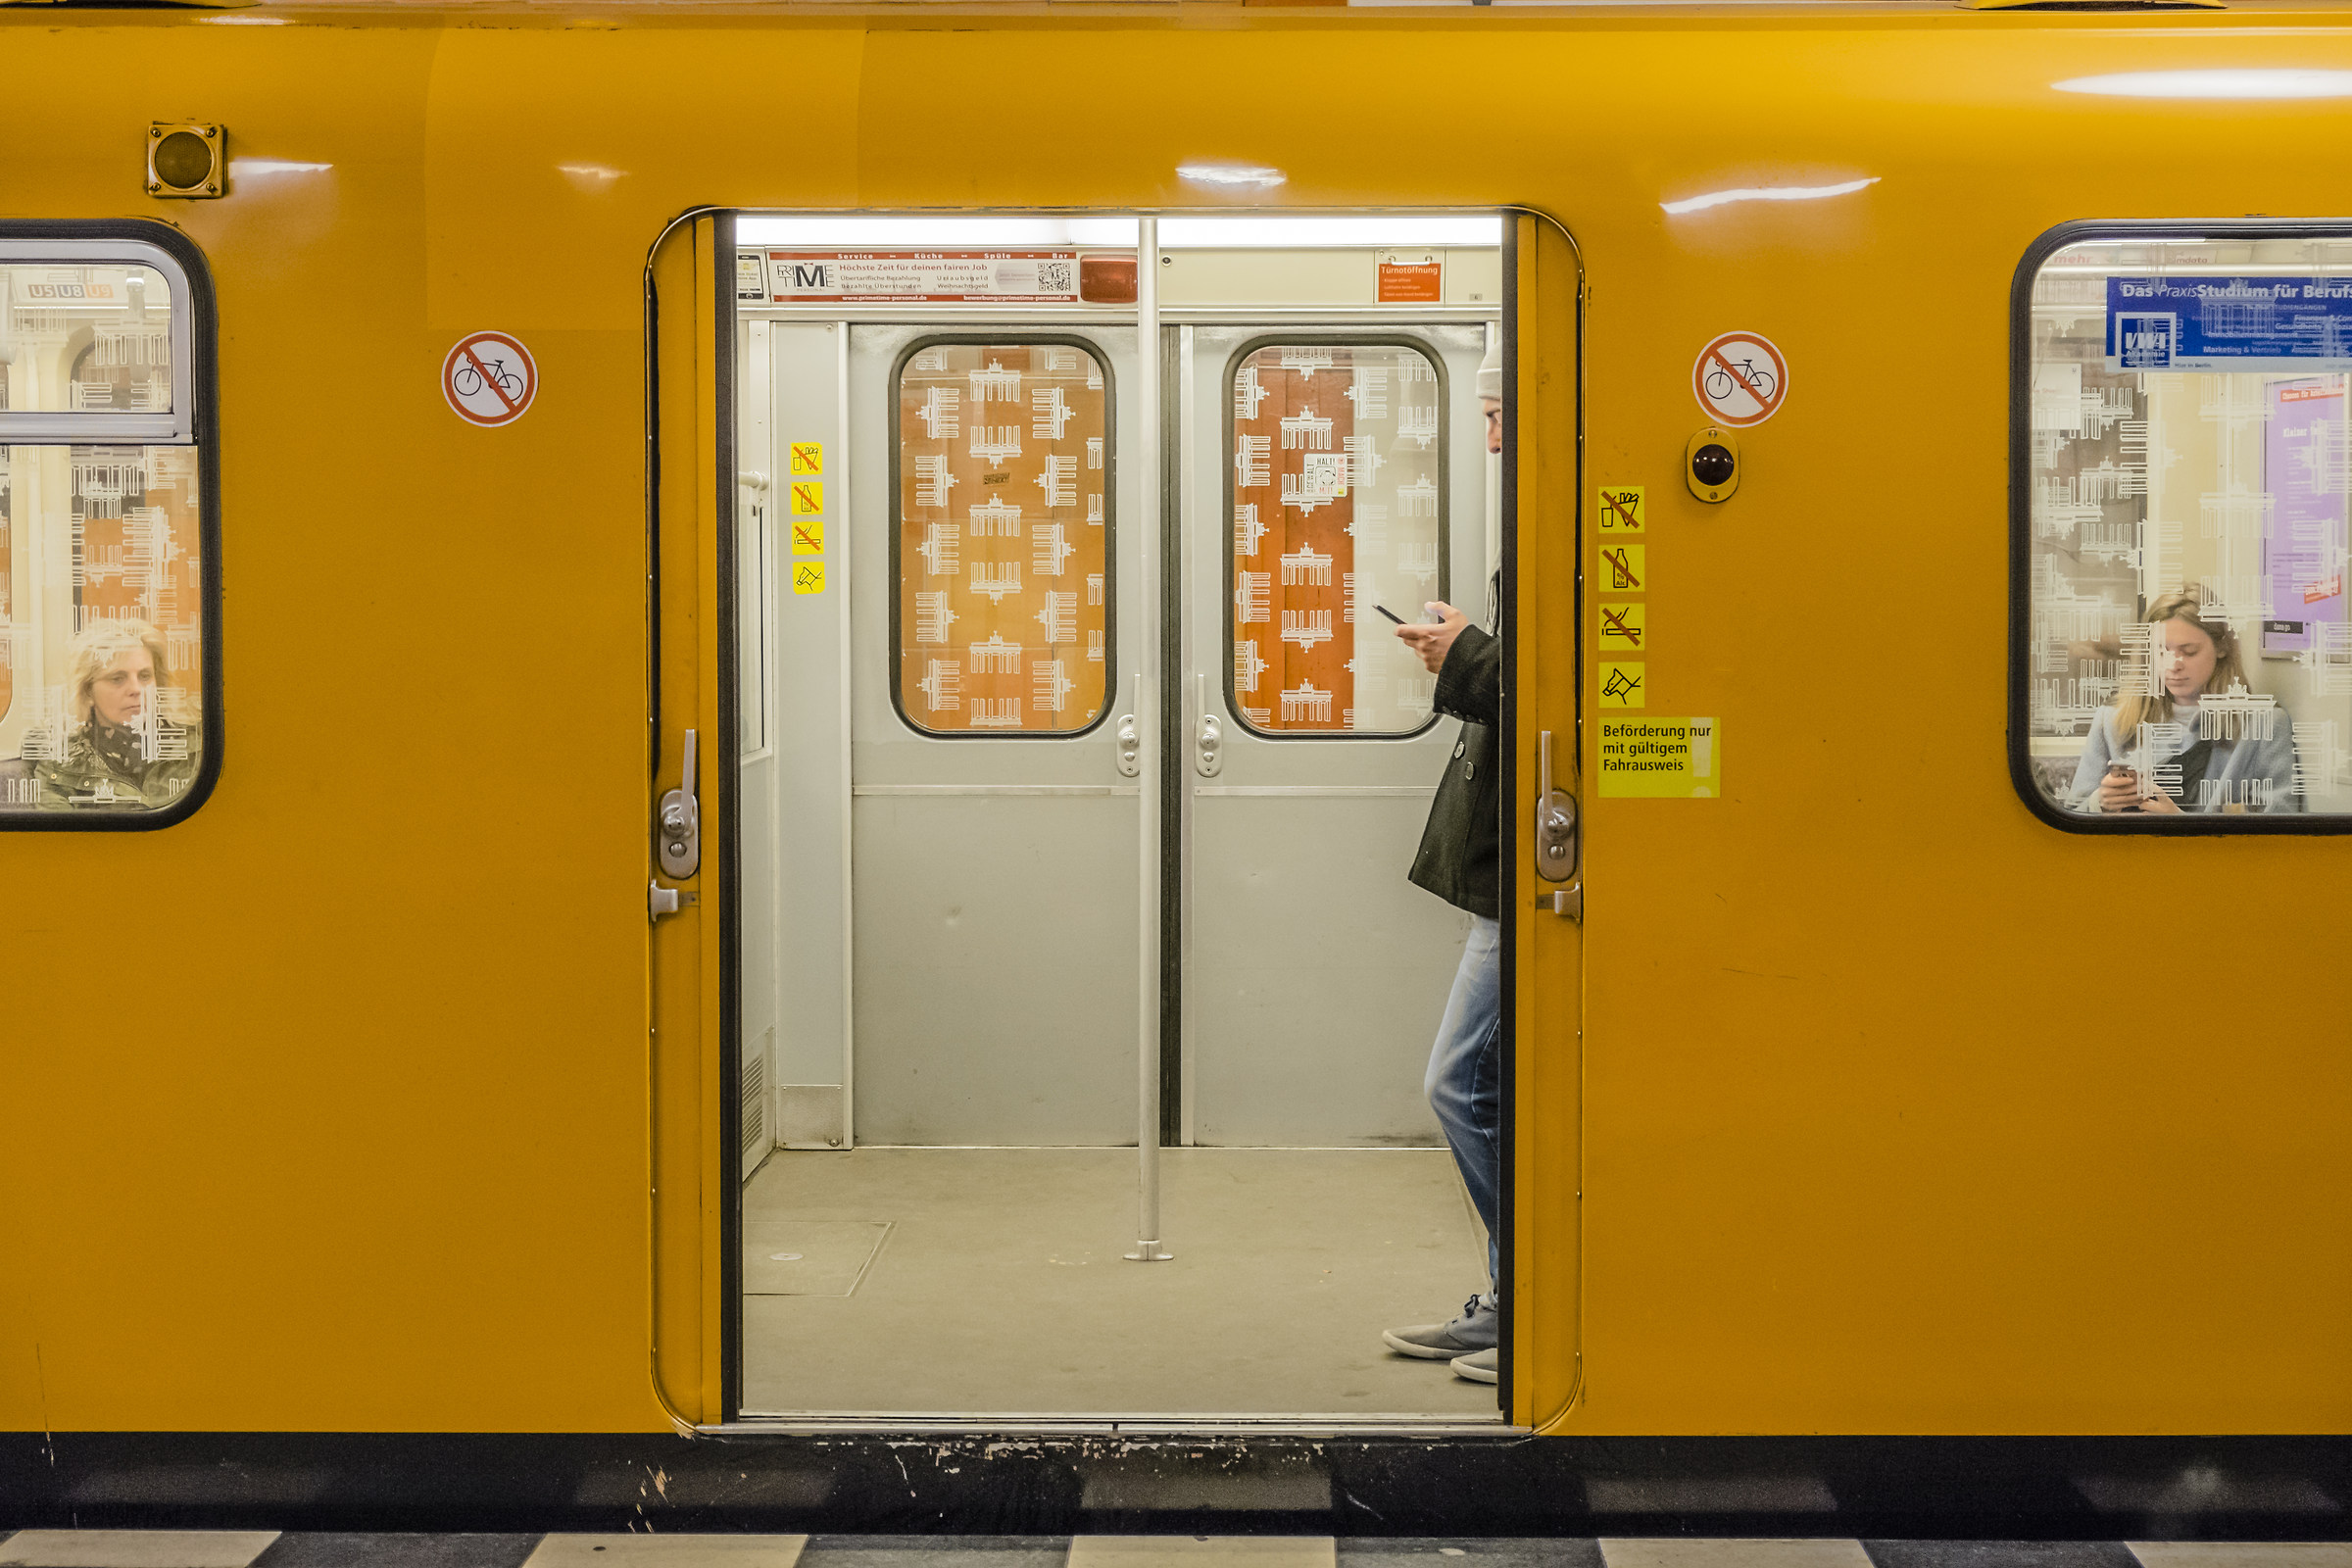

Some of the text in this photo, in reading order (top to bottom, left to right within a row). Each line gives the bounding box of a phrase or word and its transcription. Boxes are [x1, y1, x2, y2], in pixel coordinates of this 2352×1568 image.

[1381, 266, 1438, 275] Türnotöffnung
[31, 285, 111, 298] U5 U8 U9
[2123, 284, 2154, 298] Das
[2274, 283, 2299, 298] für
[2203, 345, 2242, 354] Marketing
[1603, 724, 1712, 740] Beförderung nur
[1603, 742, 1688, 757] mit gültigem
[1603, 759, 1684, 771] Fahrausweis
